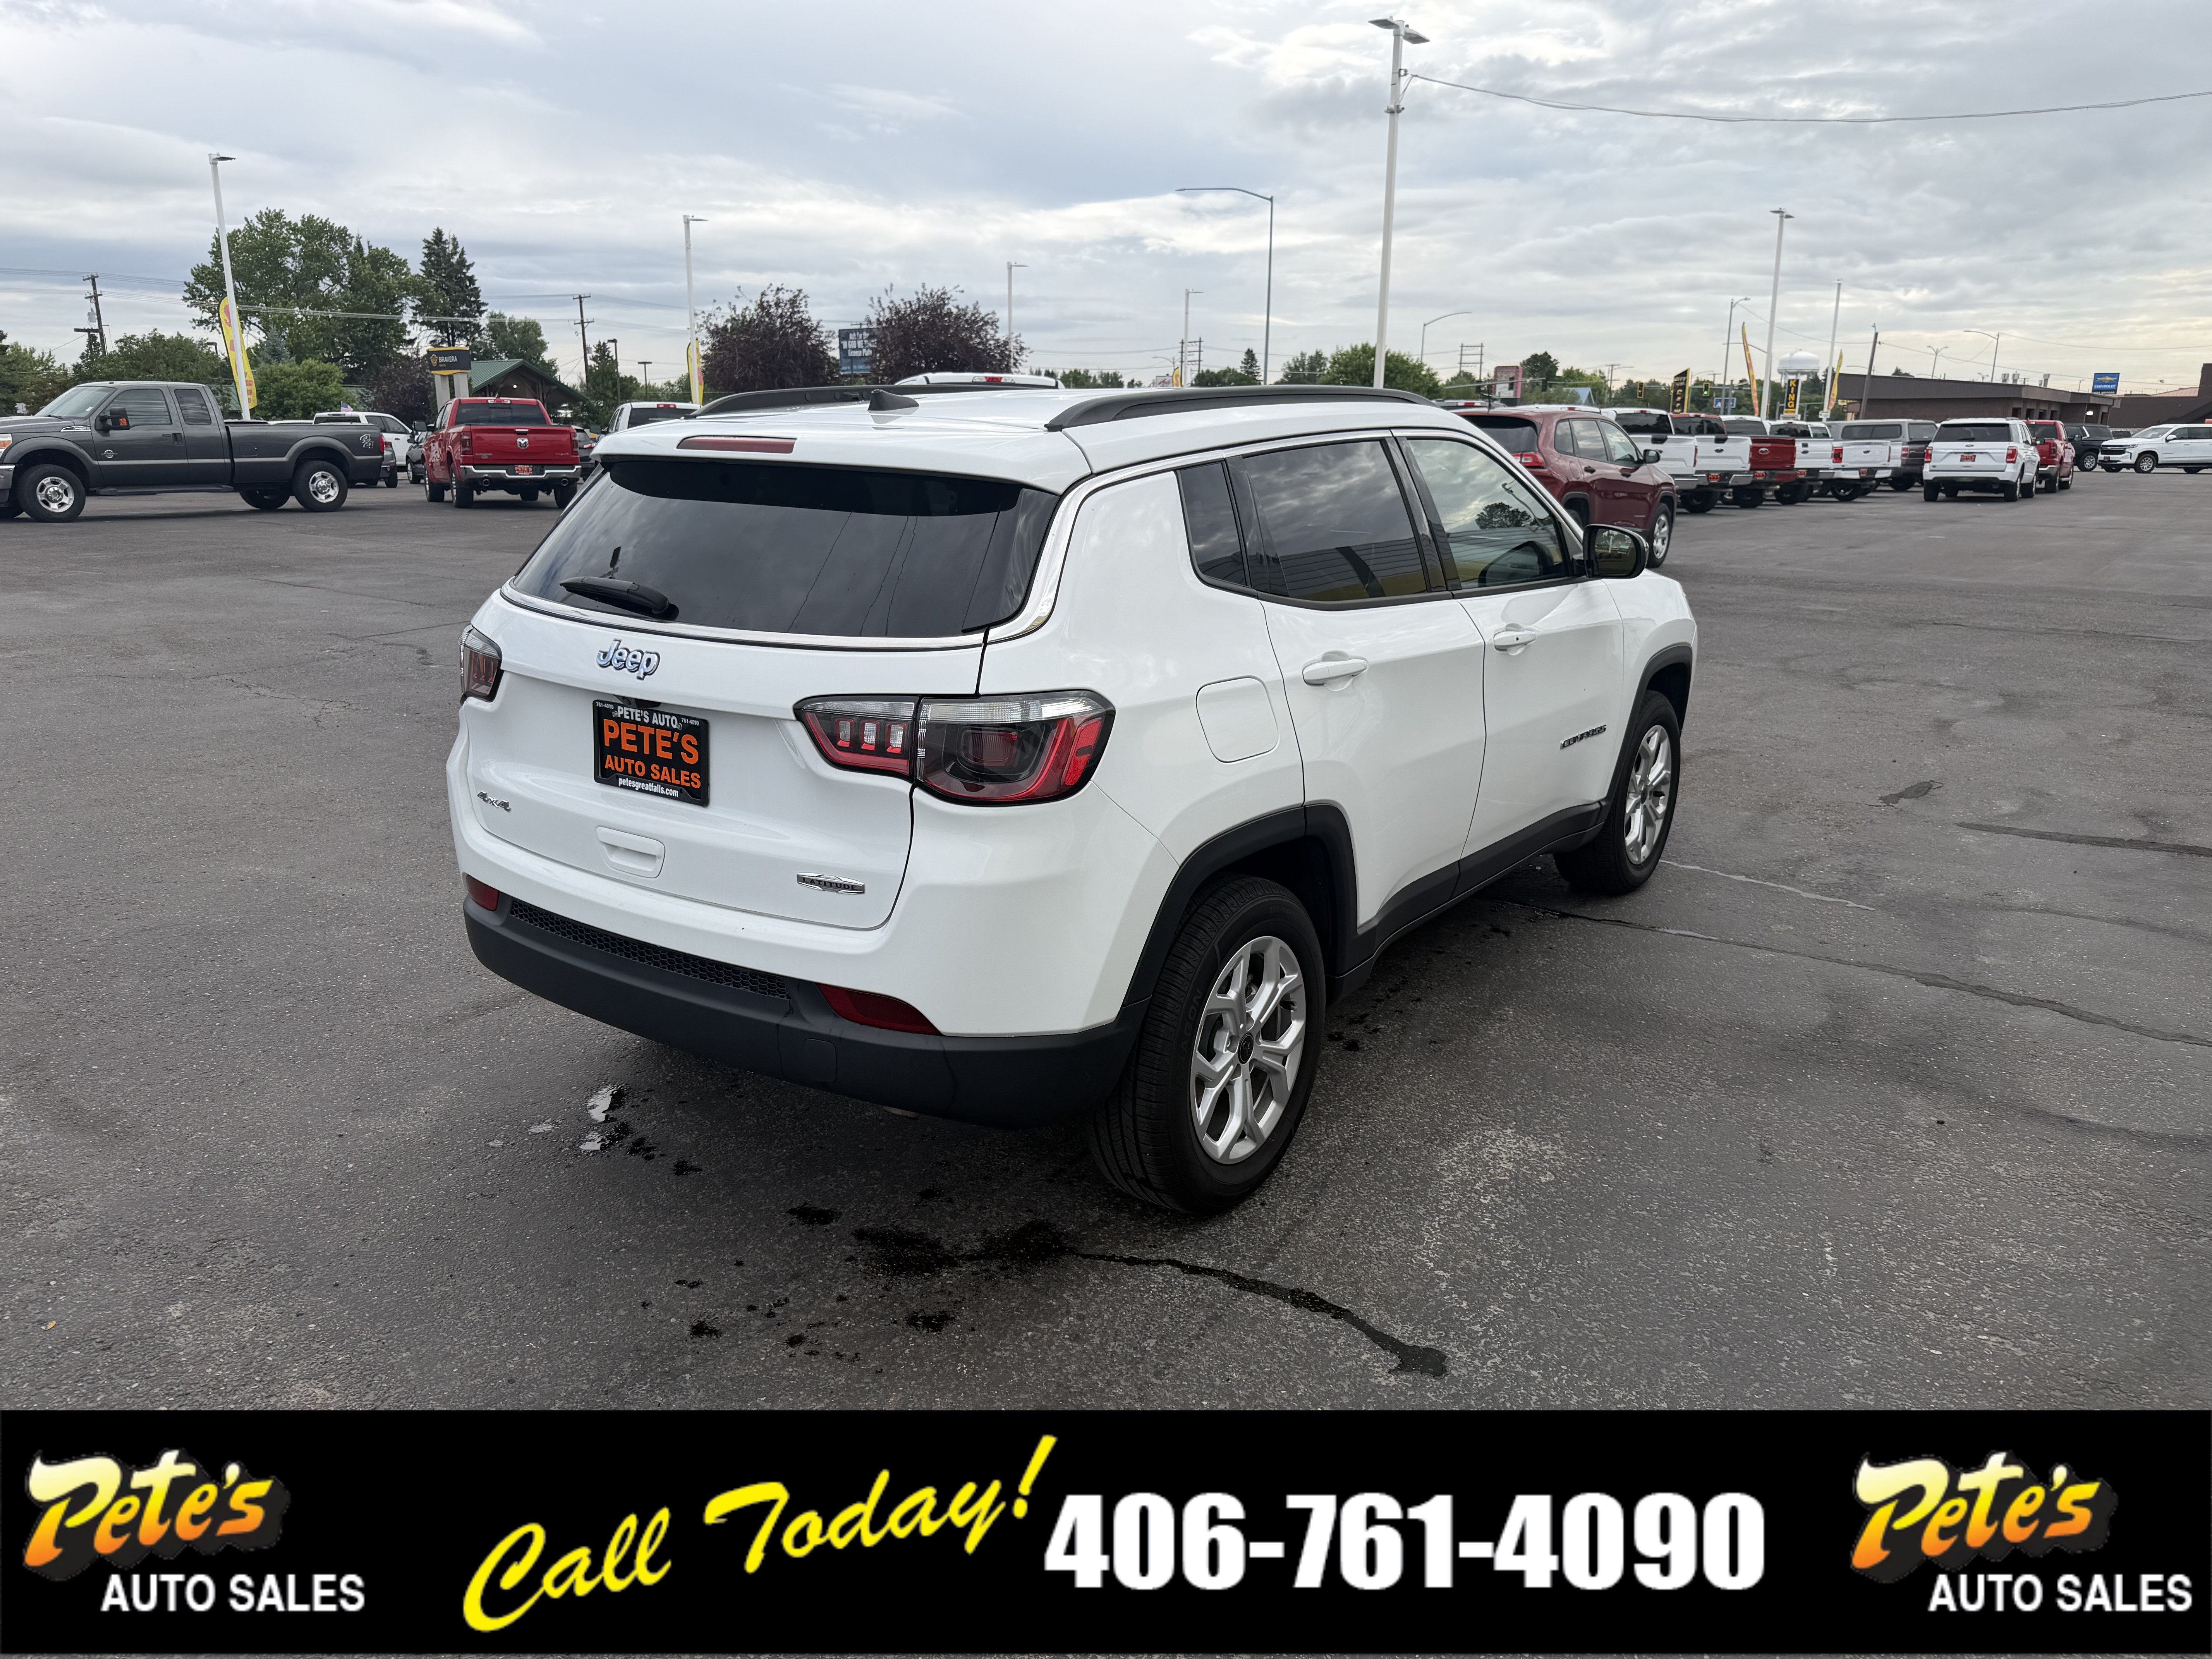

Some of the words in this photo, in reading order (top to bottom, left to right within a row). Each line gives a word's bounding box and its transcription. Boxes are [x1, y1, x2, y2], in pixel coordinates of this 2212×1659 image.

[1788, 380, 1797, 408] KING
[596, 638, 660, 680] Jeep
[617, 706, 650, 723] PETE'S
[652, 712, 677, 728] AUTO
[681, 717, 699, 726] 761-4090
[603, 718, 699, 764] PETE'S
[605, 755, 646, 776] AUTO
[651, 764, 701, 789] SALES
[618, 777, 679, 797] petesgreatfalls.com
[803, 877, 857, 890] LATITUDE
